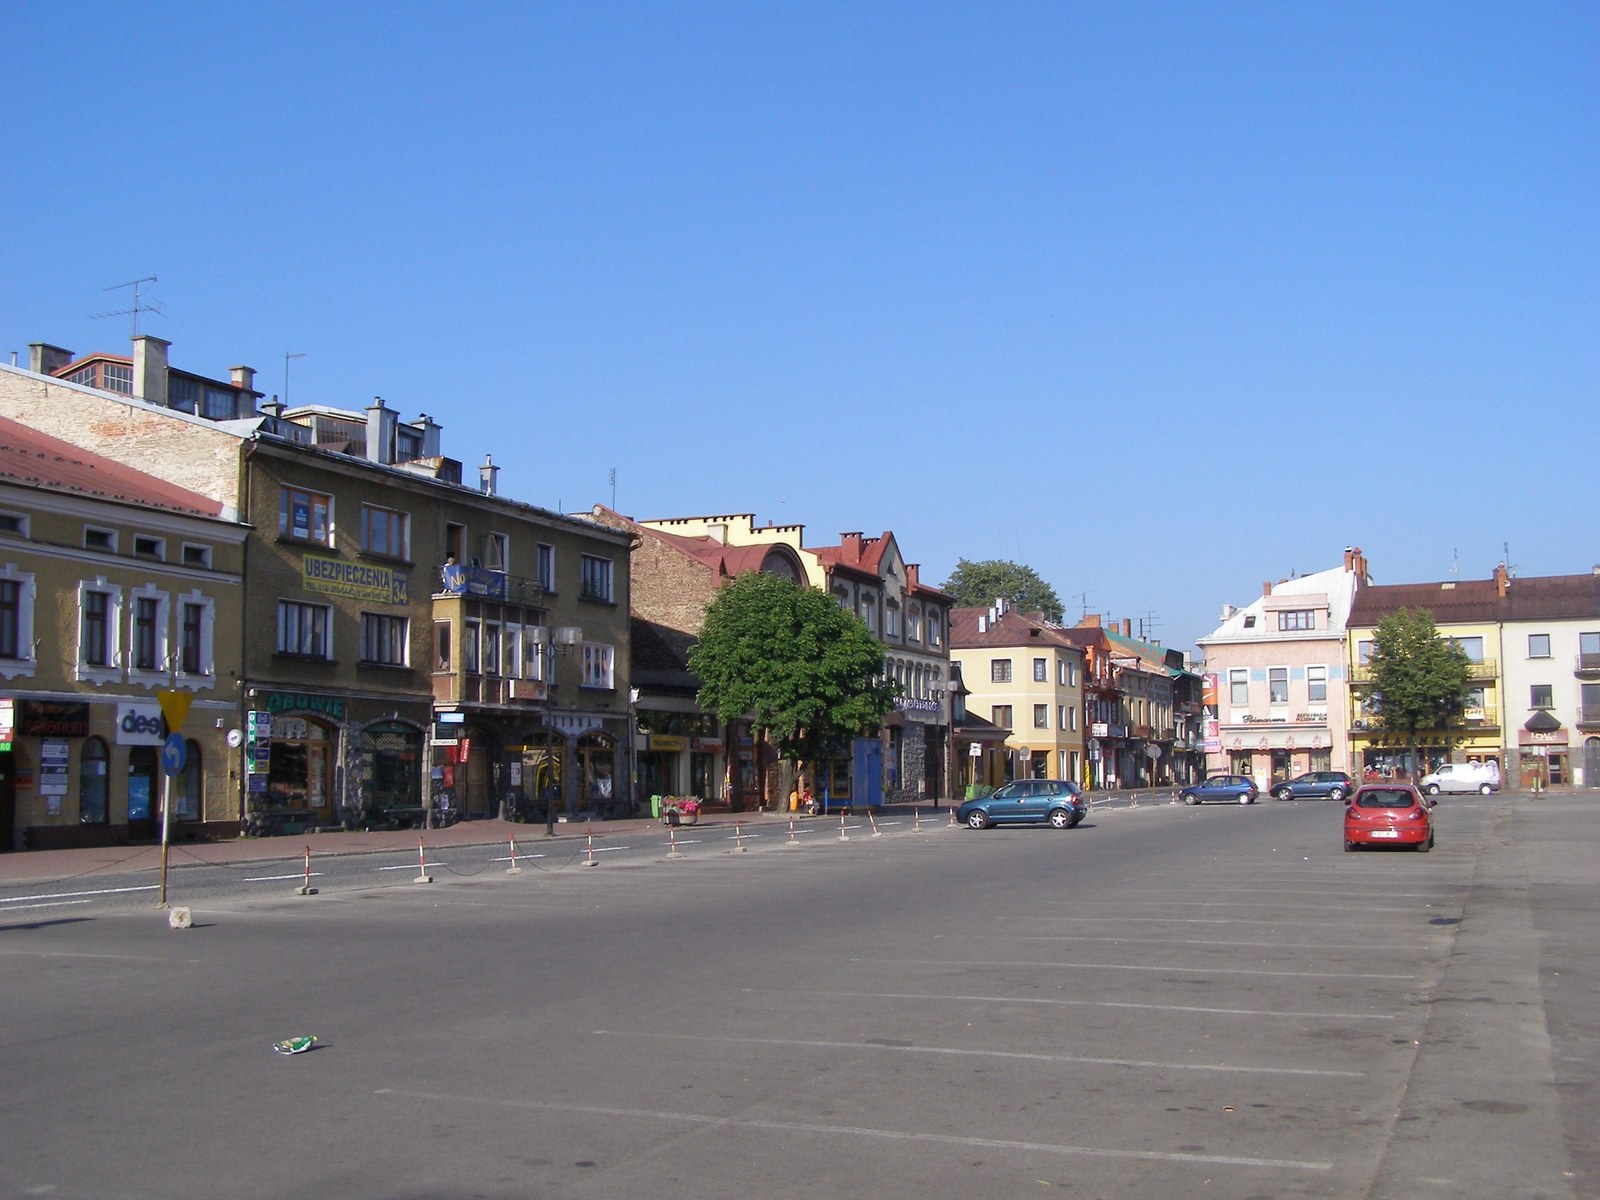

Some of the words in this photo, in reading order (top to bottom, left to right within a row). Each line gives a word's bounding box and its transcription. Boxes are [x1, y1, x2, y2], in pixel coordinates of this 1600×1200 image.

[305, 557, 390, 589] UBEZPIECZENIA
[393, 581, 408, 604] 34
[267, 693, 344, 717] OBUWIE
